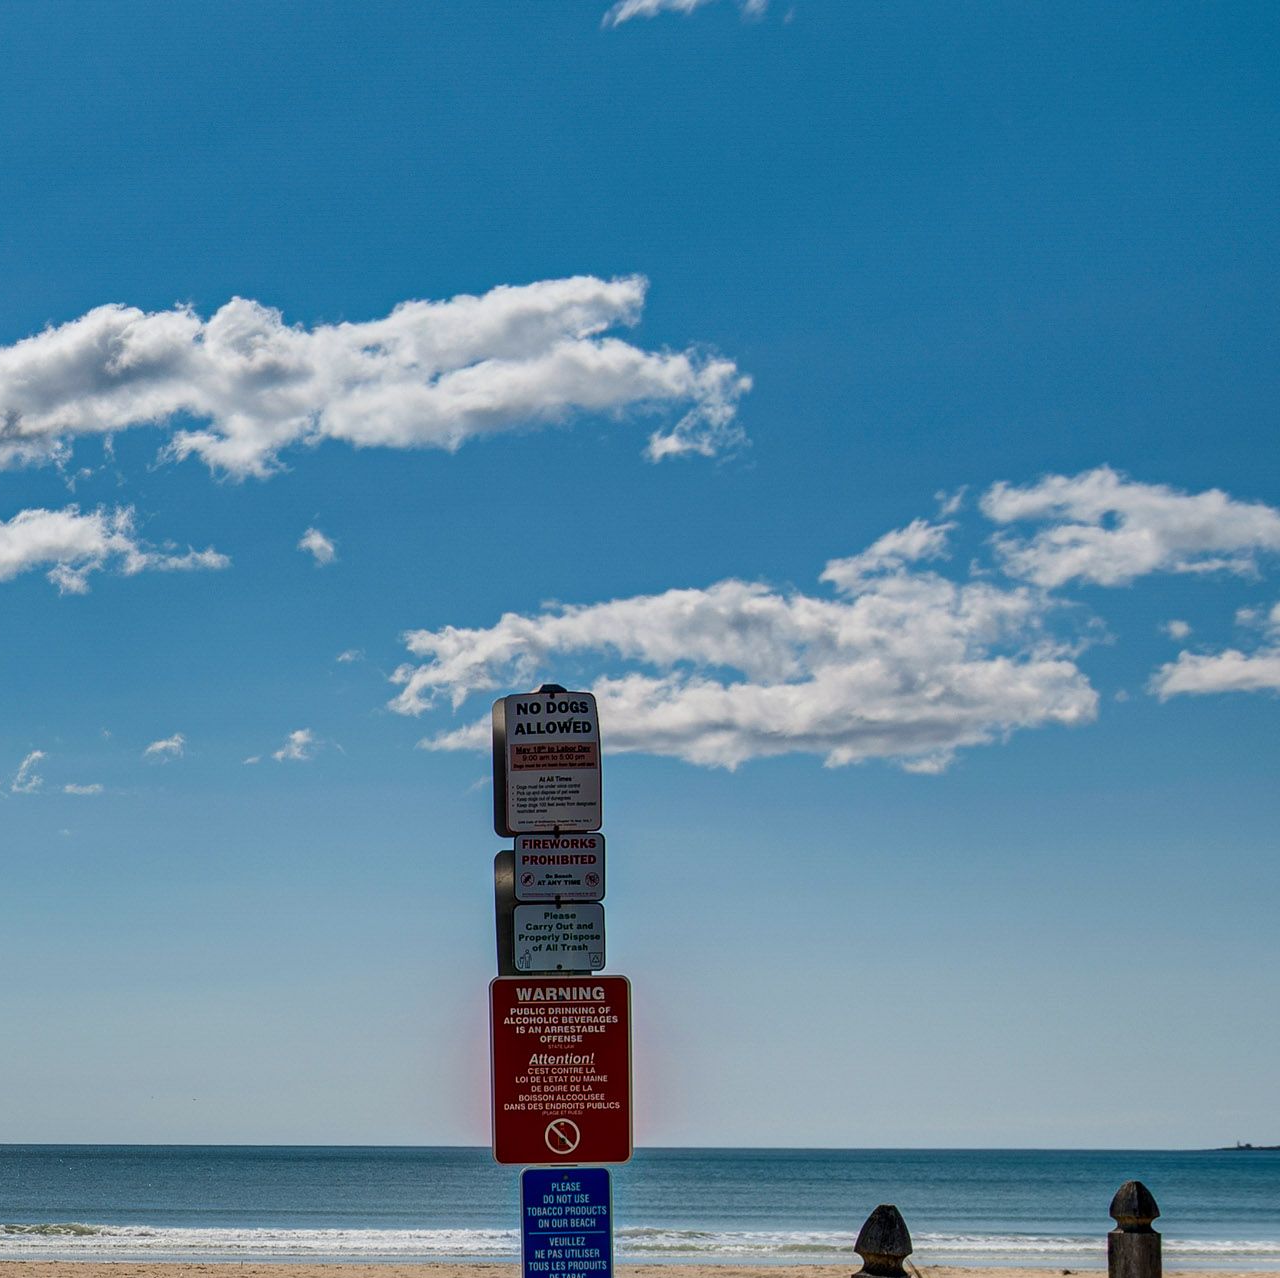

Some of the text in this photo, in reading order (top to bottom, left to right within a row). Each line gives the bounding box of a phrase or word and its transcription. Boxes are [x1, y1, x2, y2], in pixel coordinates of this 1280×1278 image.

[517, 701, 588, 715] NO DOGS
[515, 721, 591, 735] ALLOWED
[522, 839, 596, 849] FIREWORKS
[522, 855, 596, 865] PROHIBITED
[526, 923, 552, 932] Carry
[519, 934, 559, 942] Properly
[516, 987, 605, 1000] WARNING
[529, 1053, 594, 1065] Attention!
[552, 1182, 580, 1191] PLEASE
[544, 1194, 590, 1204] DO NOT USE
[528, 1206, 607, 1216] TOBACCO PRODUCTS
[539, 1218, 596, 1228] ON OUR BEACH
[549, 1237, 585, 1246] VEUILLEZ
[535, 1249, 600, 1259] NE PAS UTILISER
[528, 1261, 607, 1271] TOUS LES PRODUITS
